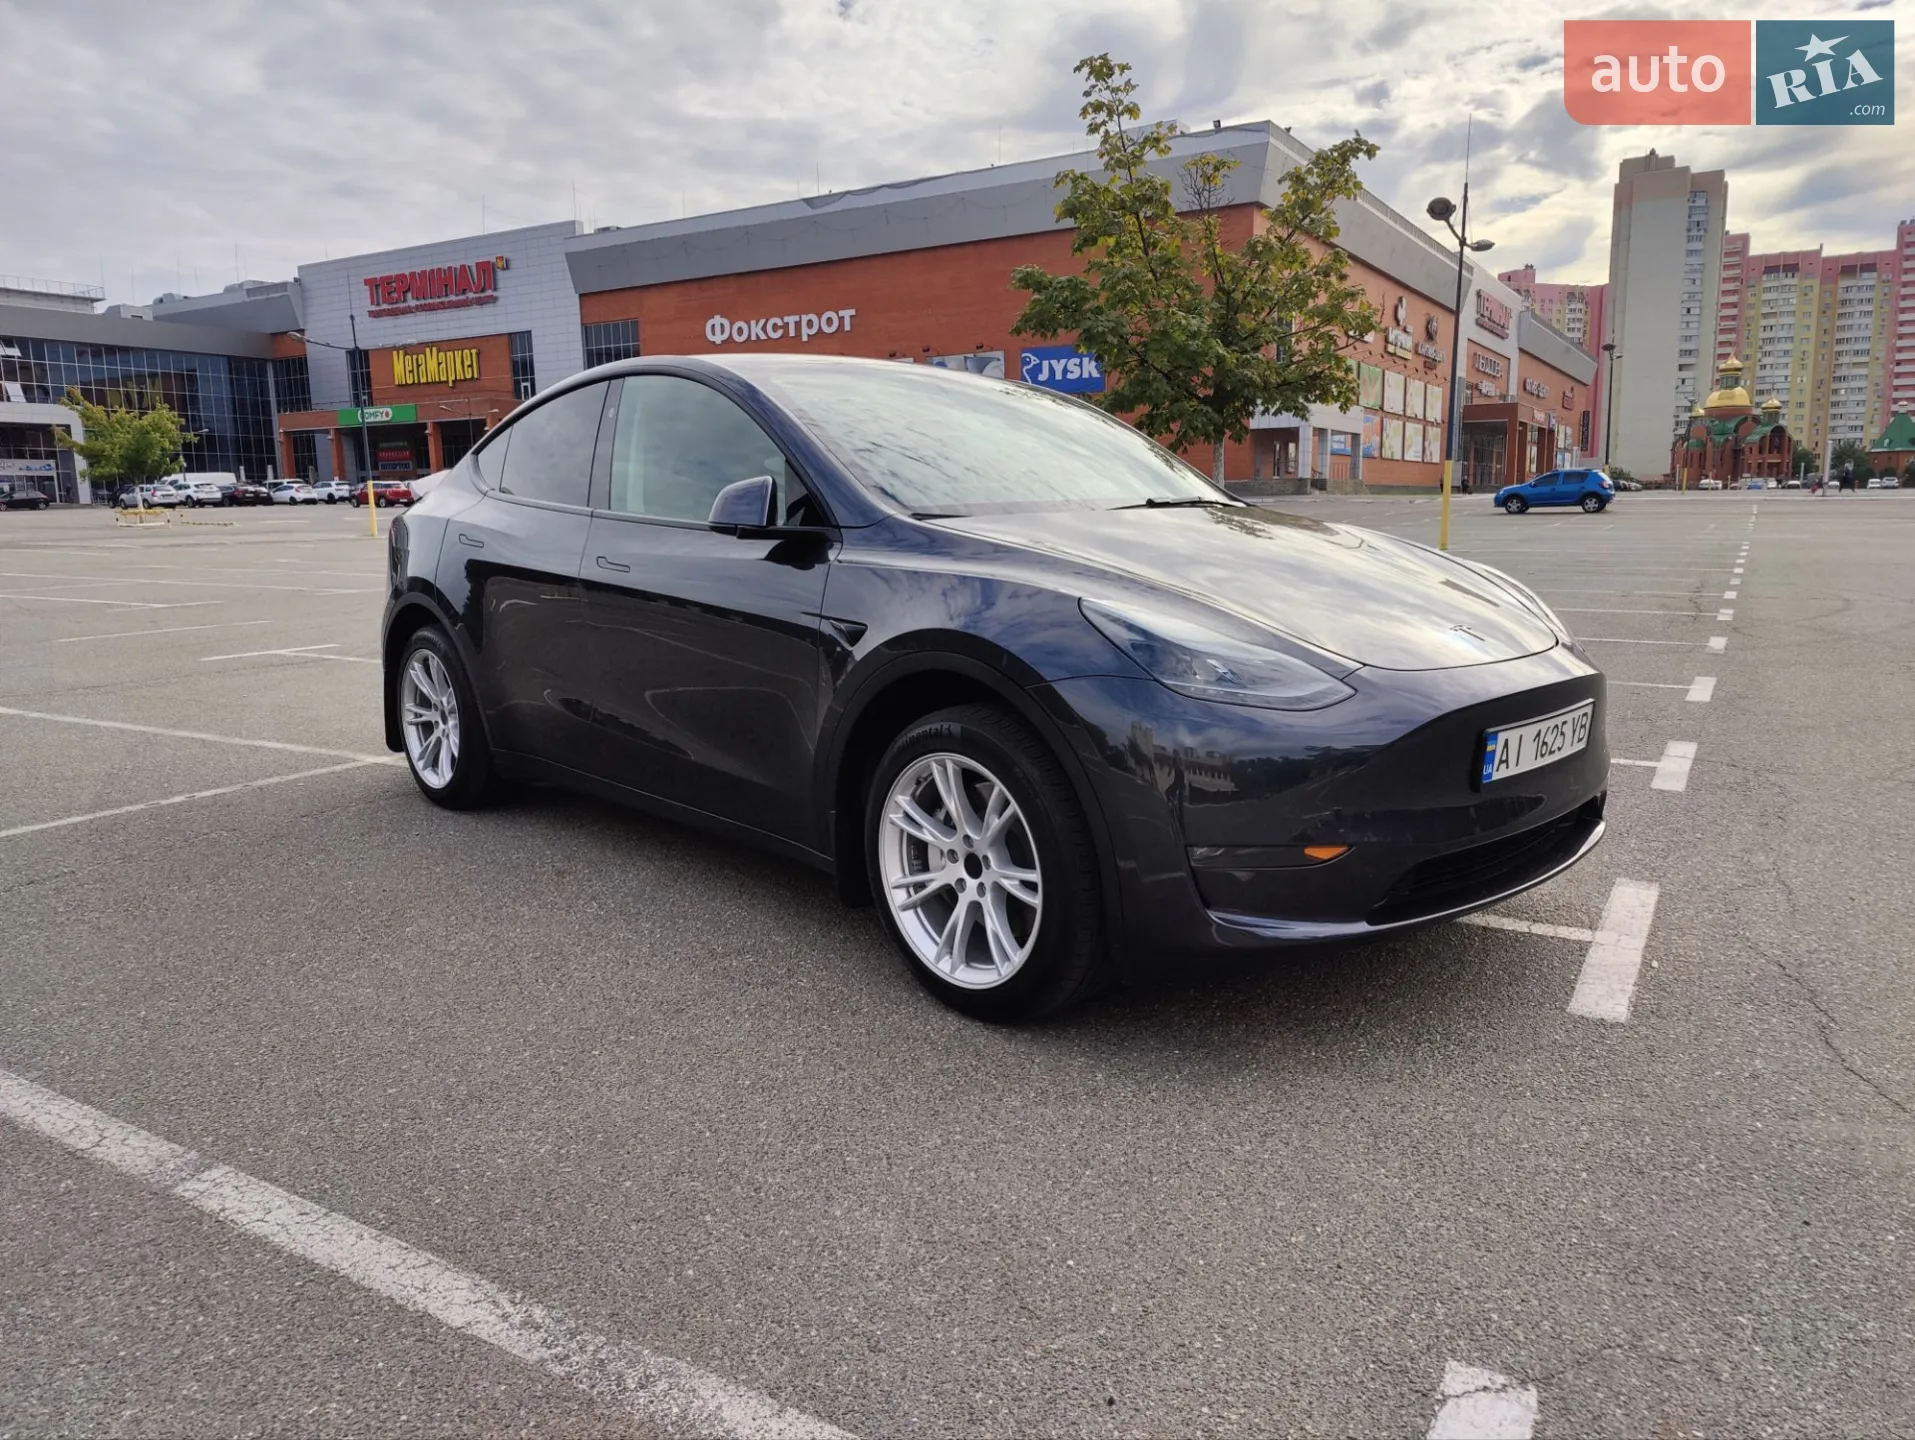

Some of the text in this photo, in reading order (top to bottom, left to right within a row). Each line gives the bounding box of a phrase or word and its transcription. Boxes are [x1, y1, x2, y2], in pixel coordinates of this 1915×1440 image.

[363, 260, 495, 306] ТЕРМІНАЛ
[705, 308, 856, 345] Фокстрот
[392, 346, 479, 387] МегаМаркет
[1038, 357, 1100, 382] JYSK
[1532, 720, 1568, 761] 1625
